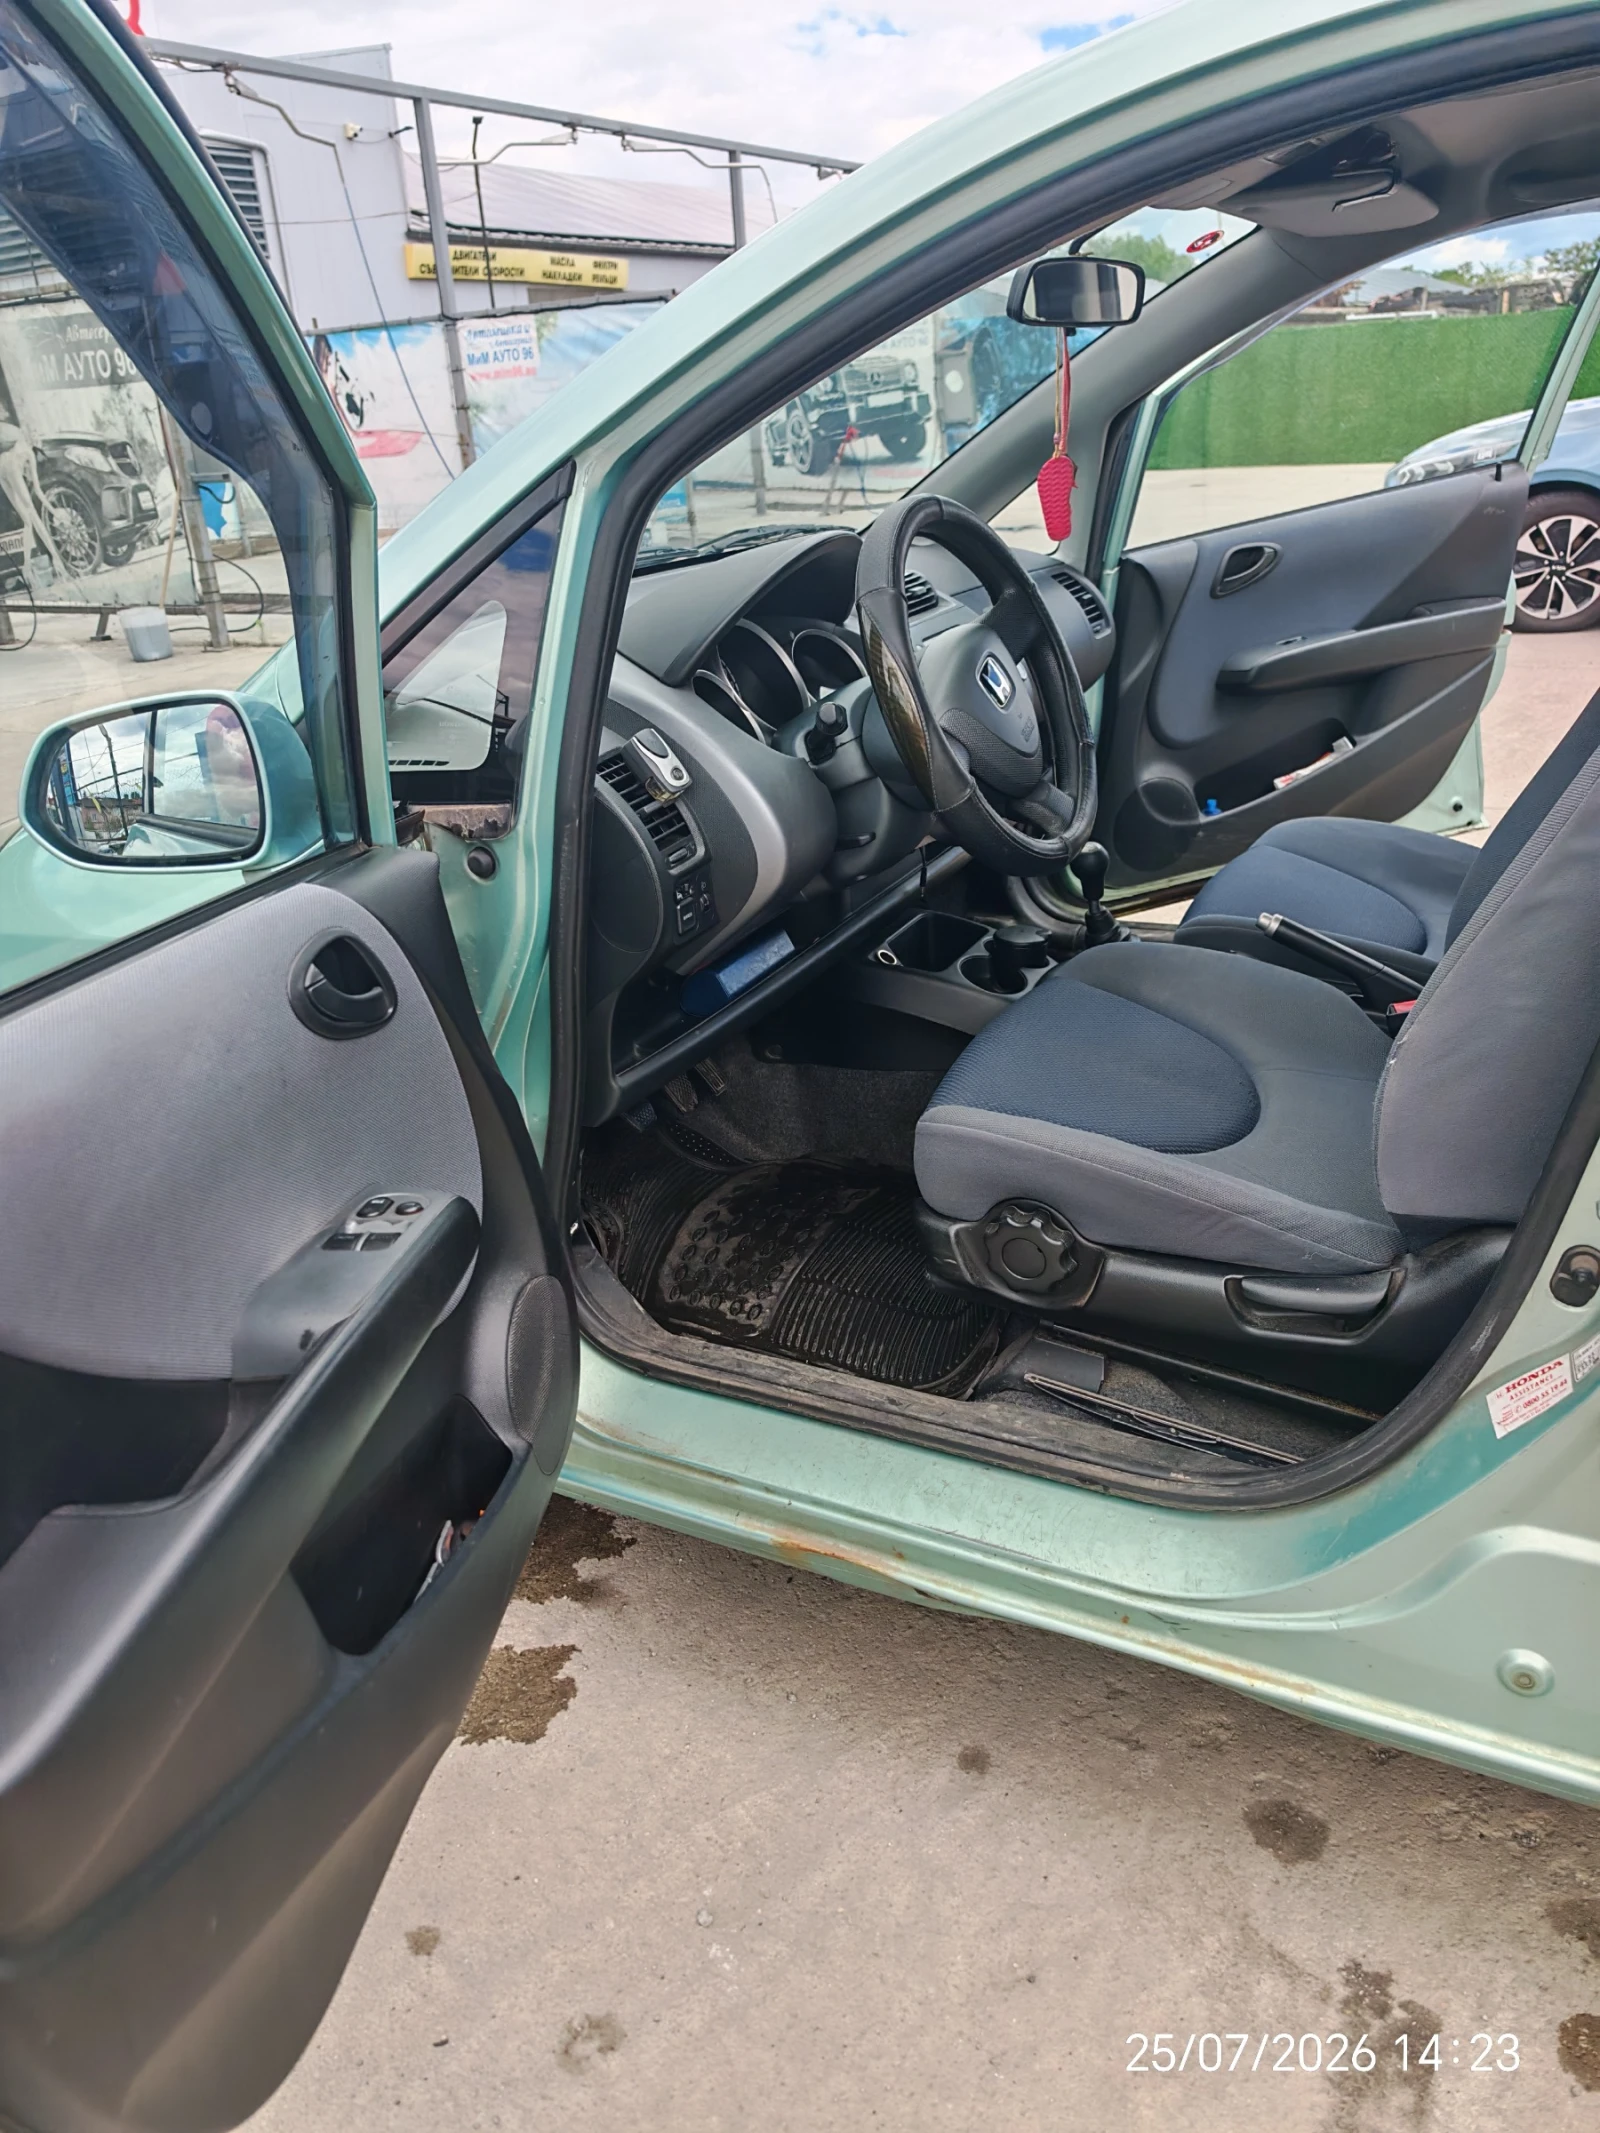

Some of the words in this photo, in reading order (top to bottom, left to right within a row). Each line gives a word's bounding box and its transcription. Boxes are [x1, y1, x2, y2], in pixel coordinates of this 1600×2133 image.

[452, 249, 497, 261] ДВИГАТЕИ
[64, 349, 112, 381] АУТО
[493, 347, 520, 362] АУТО
[522, 345, 535, 360] 96
[1505, 1360, 1563, 1393] HONDA
[1509, 1374, 1553, 1401] ASSISTANCE
